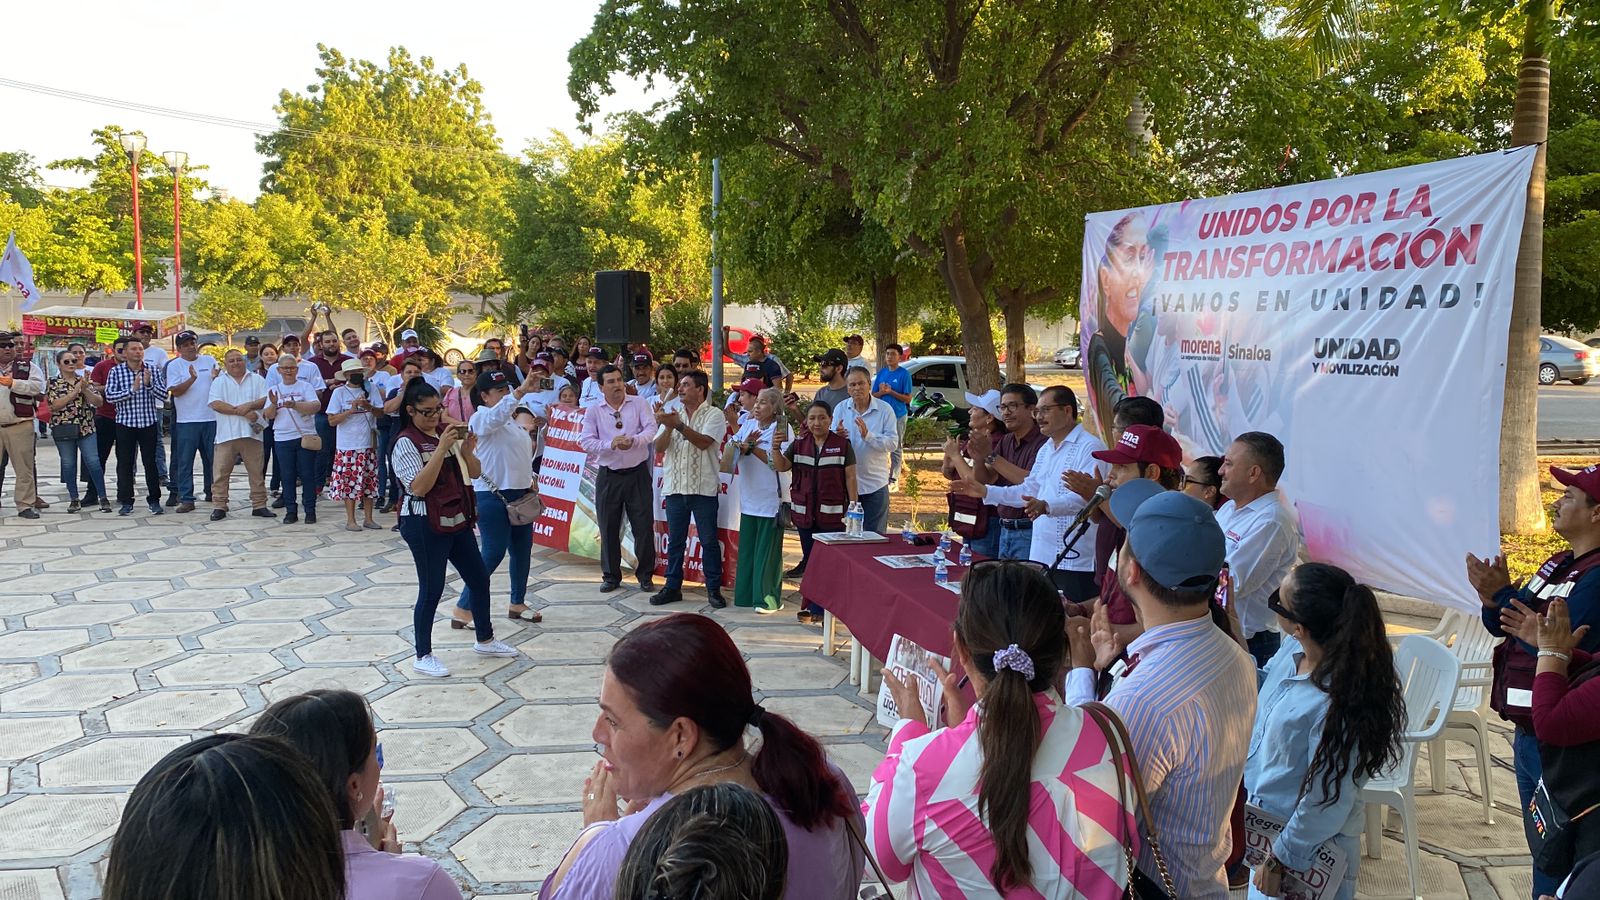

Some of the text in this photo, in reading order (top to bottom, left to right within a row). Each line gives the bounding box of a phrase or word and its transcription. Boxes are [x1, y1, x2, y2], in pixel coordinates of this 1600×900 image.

[1198, 184, 1433, 240] UNIDOS POR LA
[1162, 217, 1484, 282] TRANSFORMACIÓN
[1152, 290, 1240, 316] ¡VAMOS
[1256, 289, 1291, 312] EN
[46, 317, 117, 329] DIABLITOS
[1181, 339, 1272, 361] morena Sinaloa
[1314, 338, 1400, 360] UNIDAD
[1312, 362, 1400, 377] Y MOVILIZACIÓN
